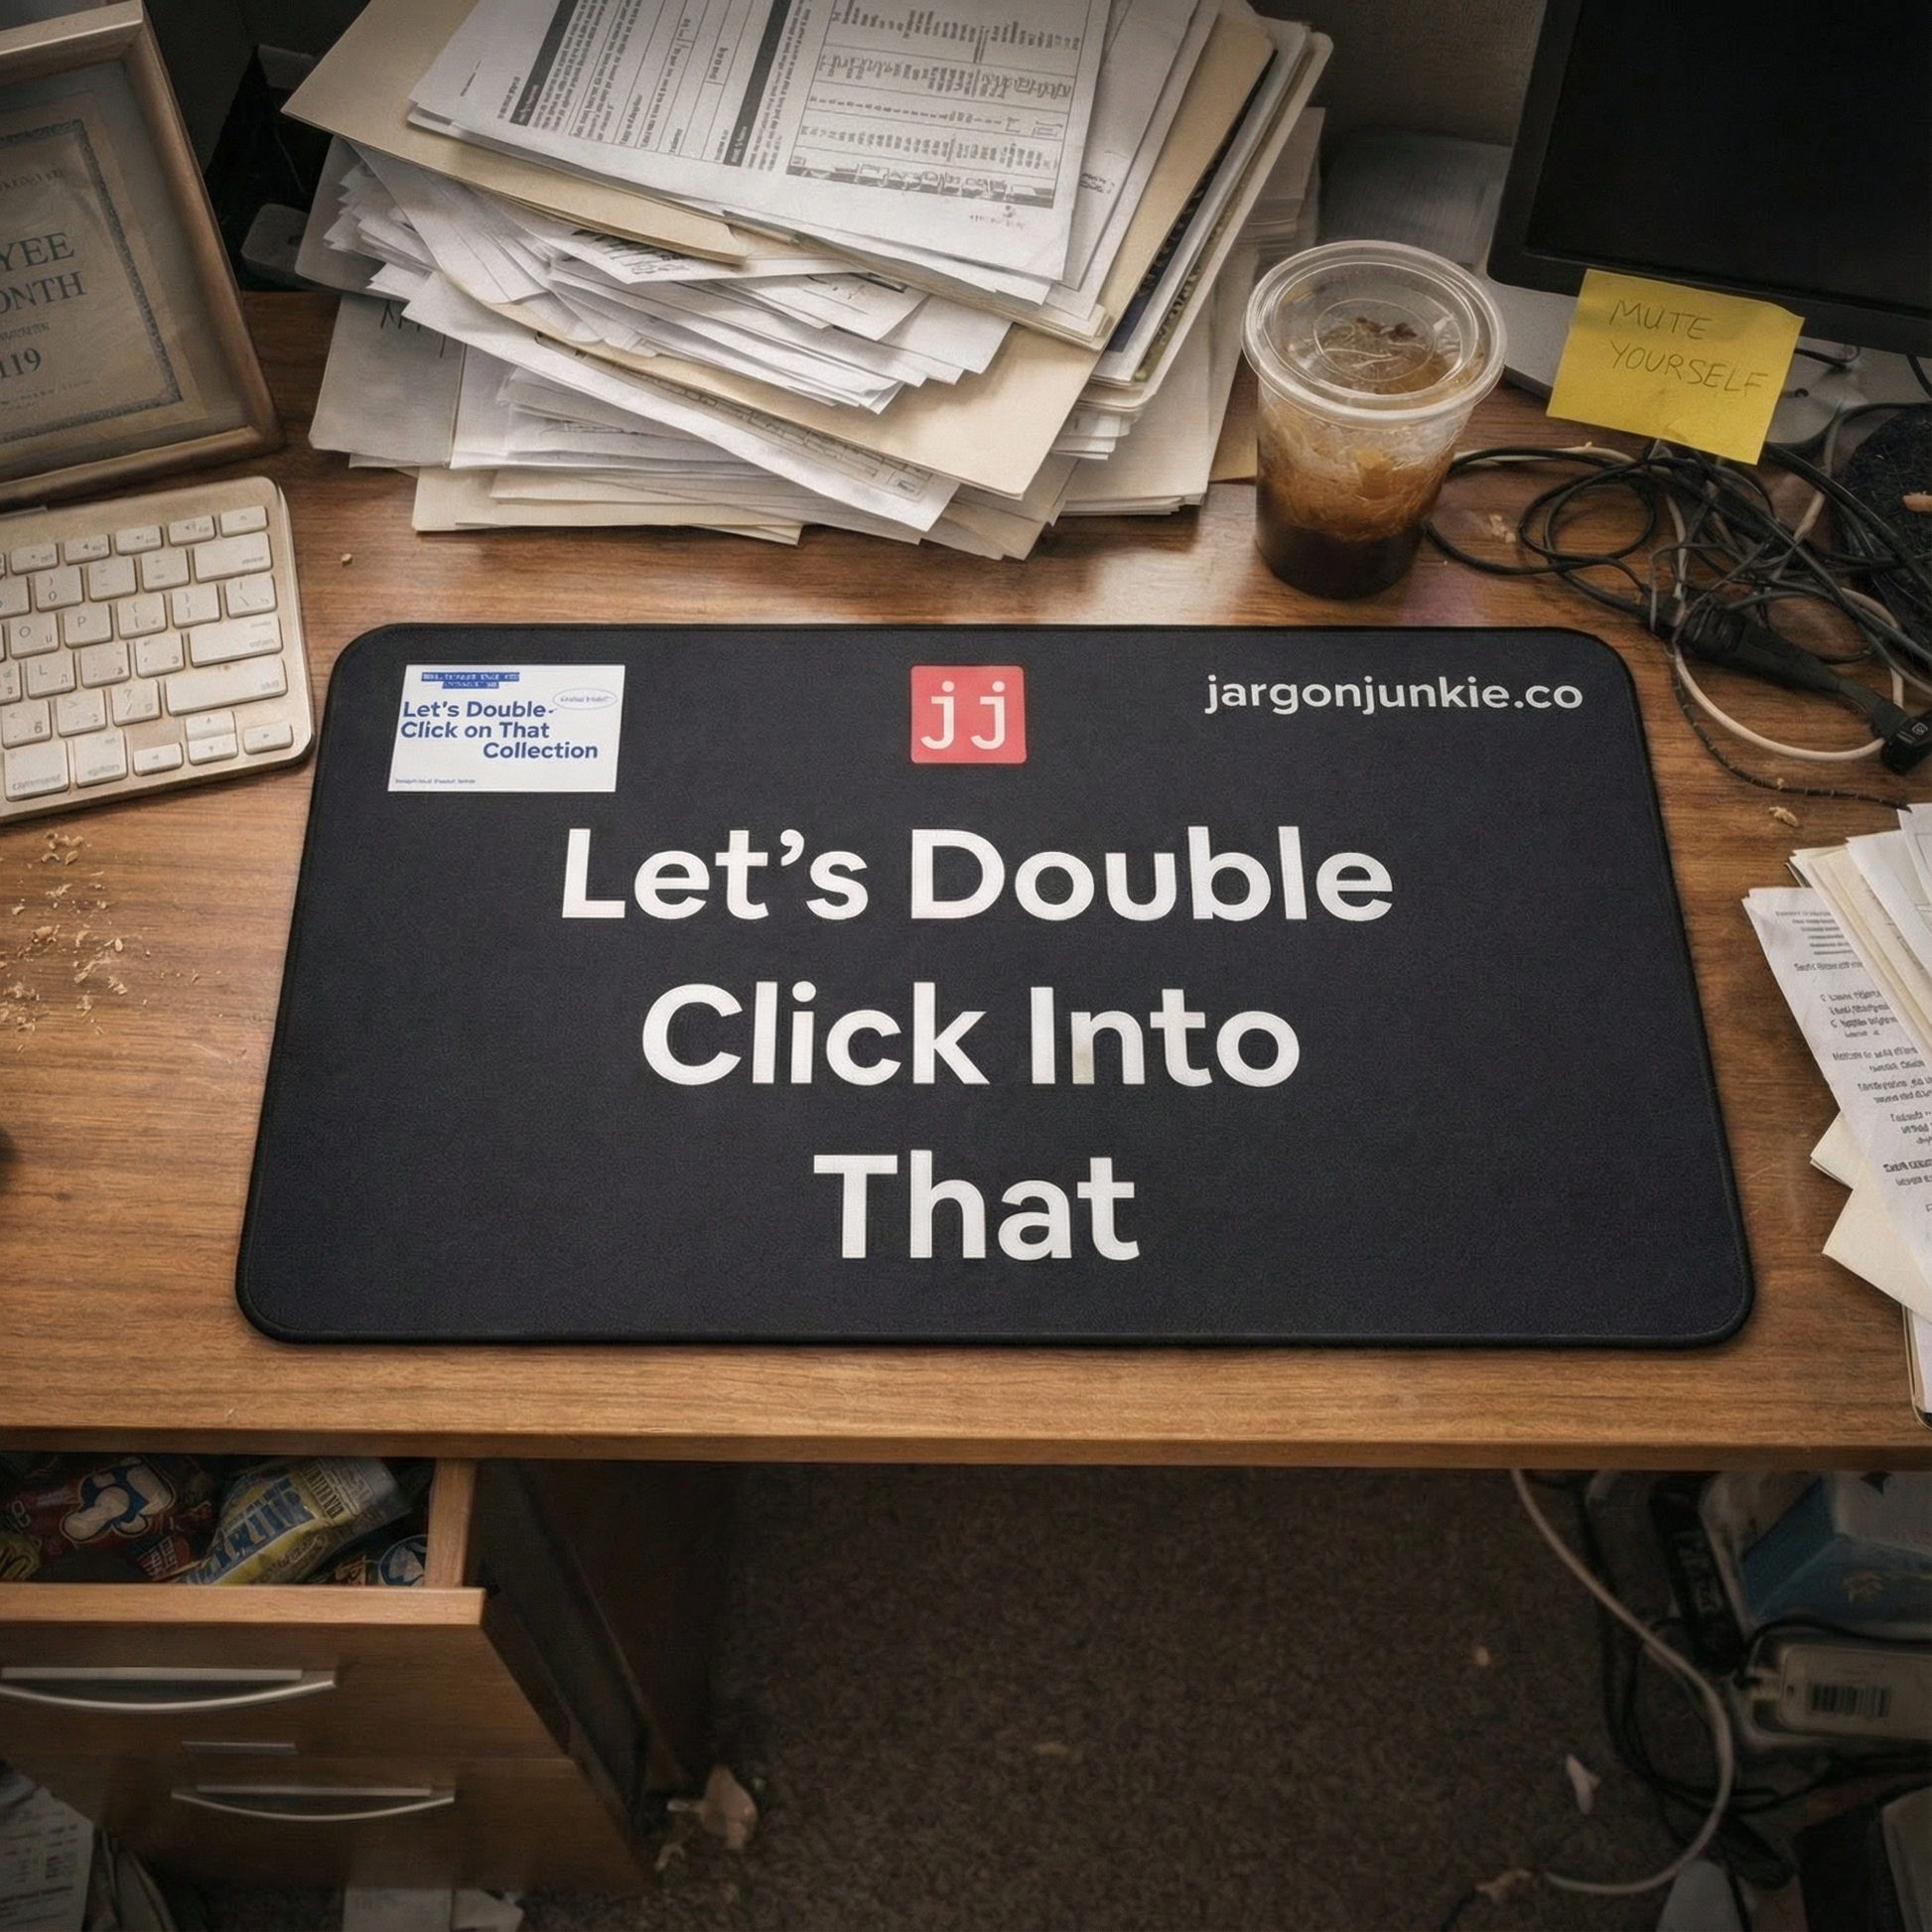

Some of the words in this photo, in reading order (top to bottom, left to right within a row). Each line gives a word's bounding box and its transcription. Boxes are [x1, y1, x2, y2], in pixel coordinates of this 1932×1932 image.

[1608, 299, 1714, 340] MUTE
[1608, 339, 1769, 397] YOURSELF
[403, 701, 460, 718] Let's
[1204, 674, 1584, 715] jargonjunkie.co
[400, 721, 458, 739] Click
[464, 725, 492, 739] on
[498, 721, 550, 739] That
[483, 742, 598, 759] Collection
[561, 828, 869, 920] Let's
[910, 825, 1393, 922] Double
[642, 980, 990, 1086] Click
[1031, 986, 1300, 1087] Into
[813, 1149, 1140, 1261] That
